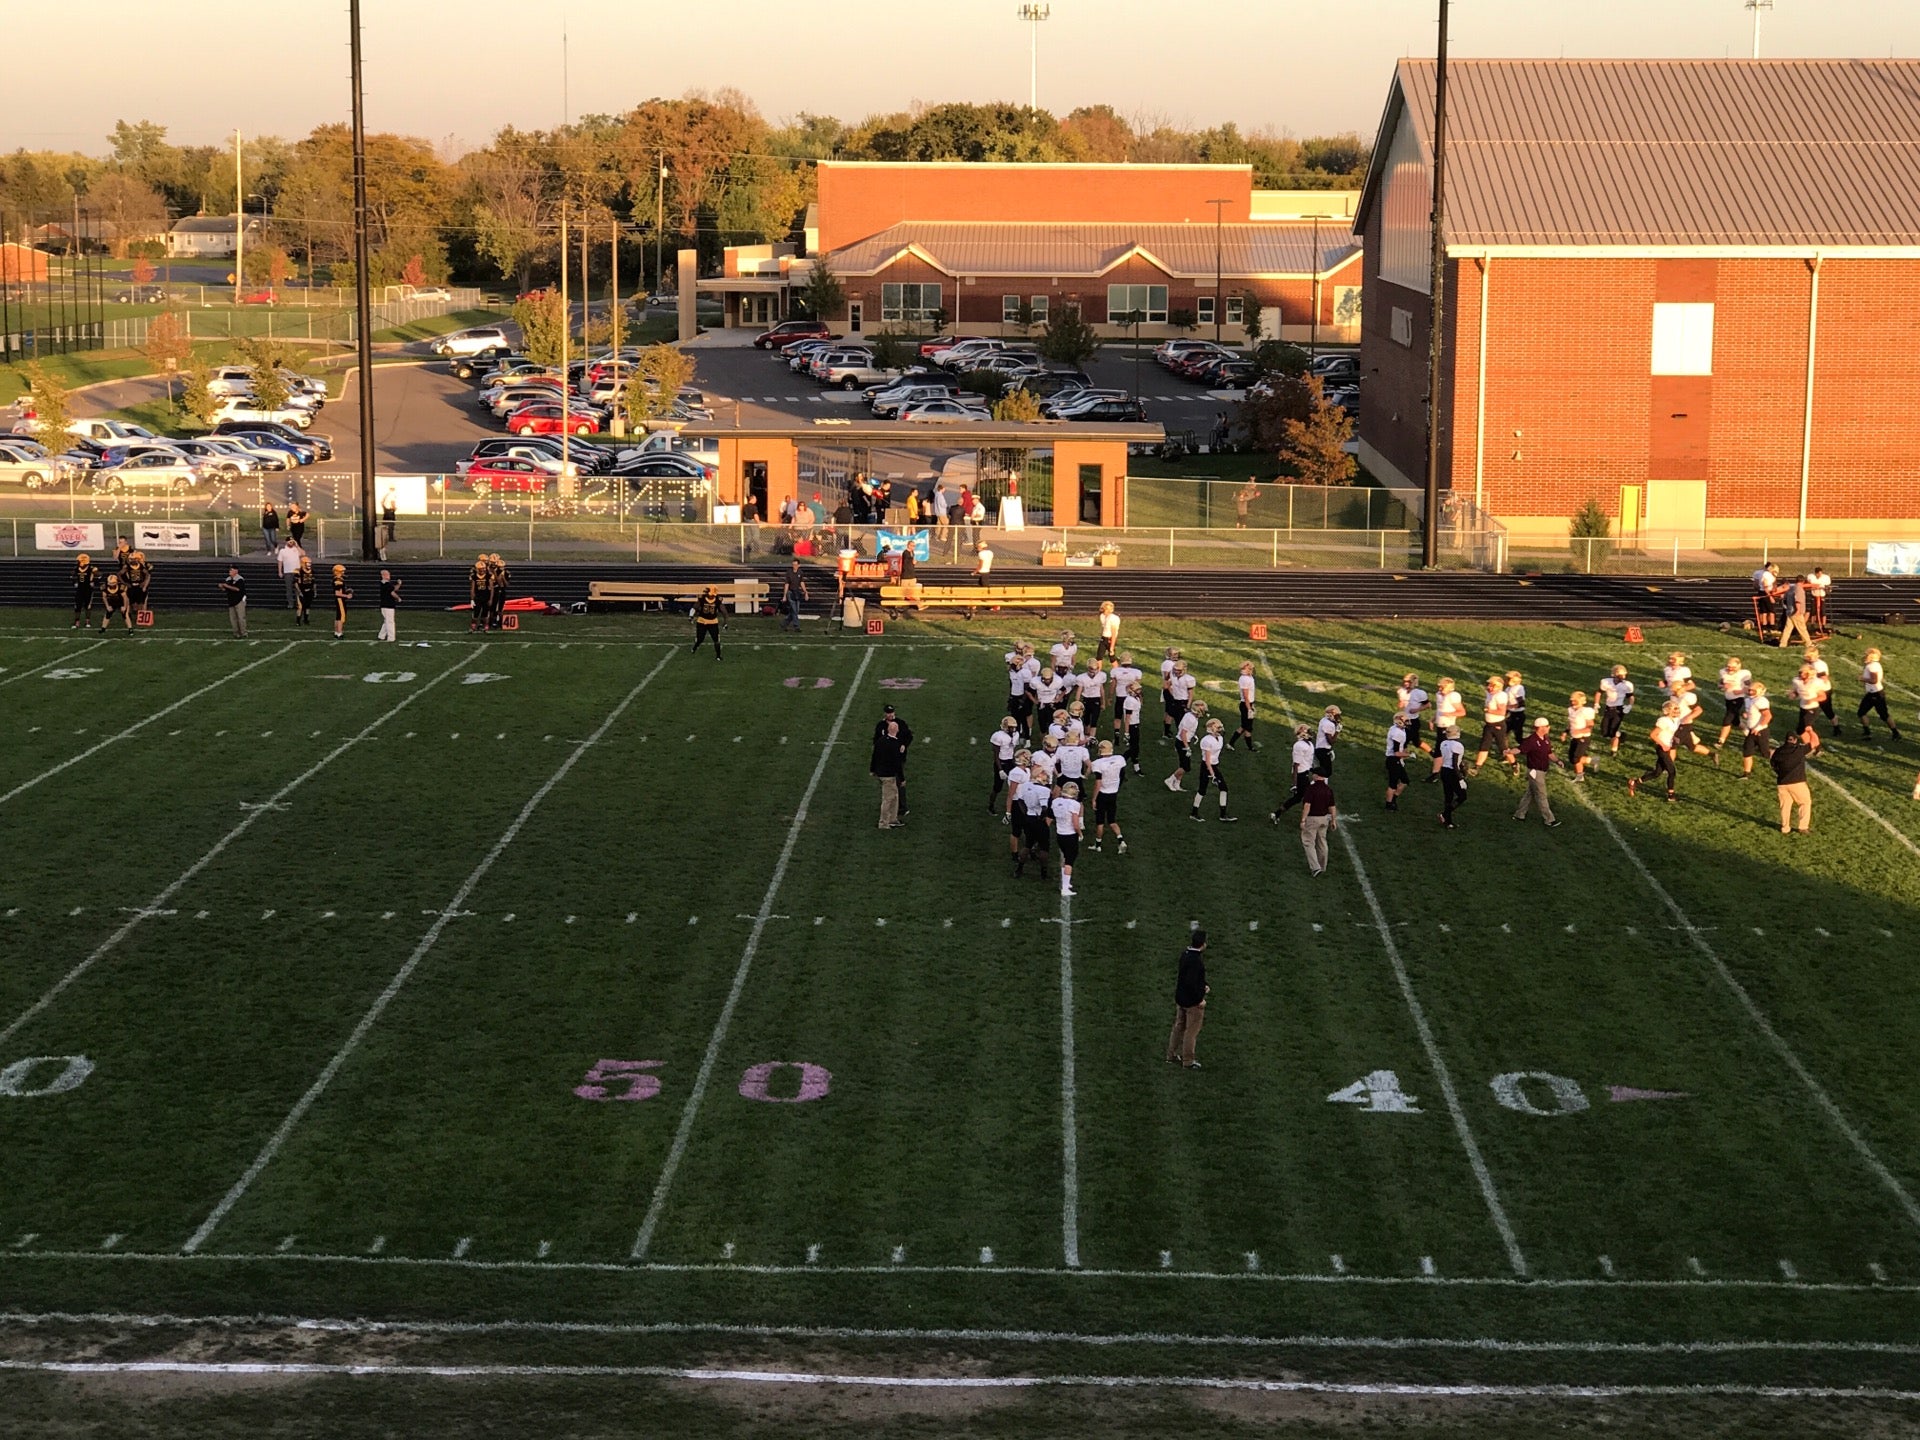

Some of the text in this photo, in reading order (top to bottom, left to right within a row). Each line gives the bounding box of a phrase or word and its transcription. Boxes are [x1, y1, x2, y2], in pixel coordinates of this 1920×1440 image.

[137, 610, 151, 624] 30
[503, 615, 516, 628] 40
[869, 620, 882, 632] 50
[1253, 625, 1266, 638] 40
[1629, 627, 1643, 640] 30
